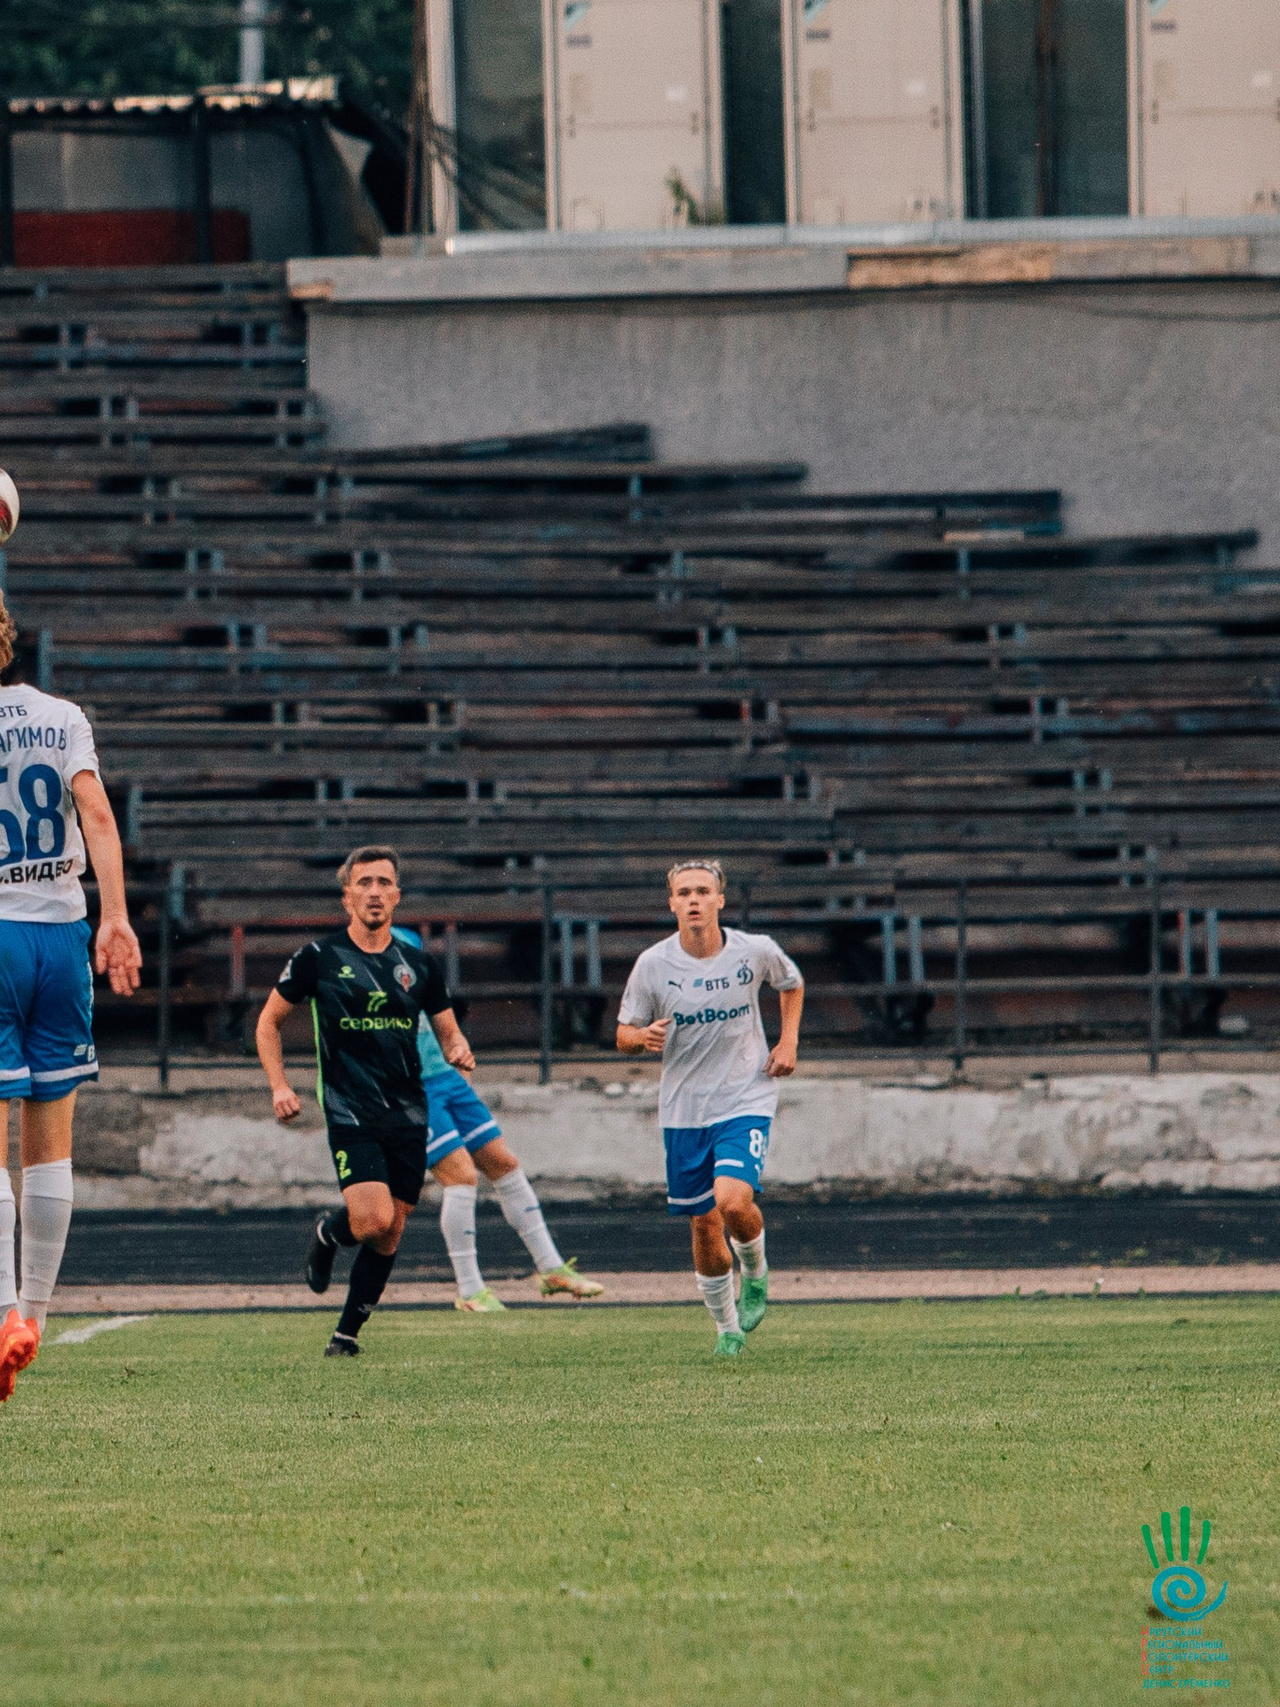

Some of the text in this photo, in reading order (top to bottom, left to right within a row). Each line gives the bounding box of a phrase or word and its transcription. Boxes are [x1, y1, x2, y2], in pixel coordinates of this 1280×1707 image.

[705, 977, 730, 991] ВТБ
[673, 1004, 750, 1026] BetBoom
[749, 1128, 763, 1159] 8
[336, 1150, 352, 1179] 2
